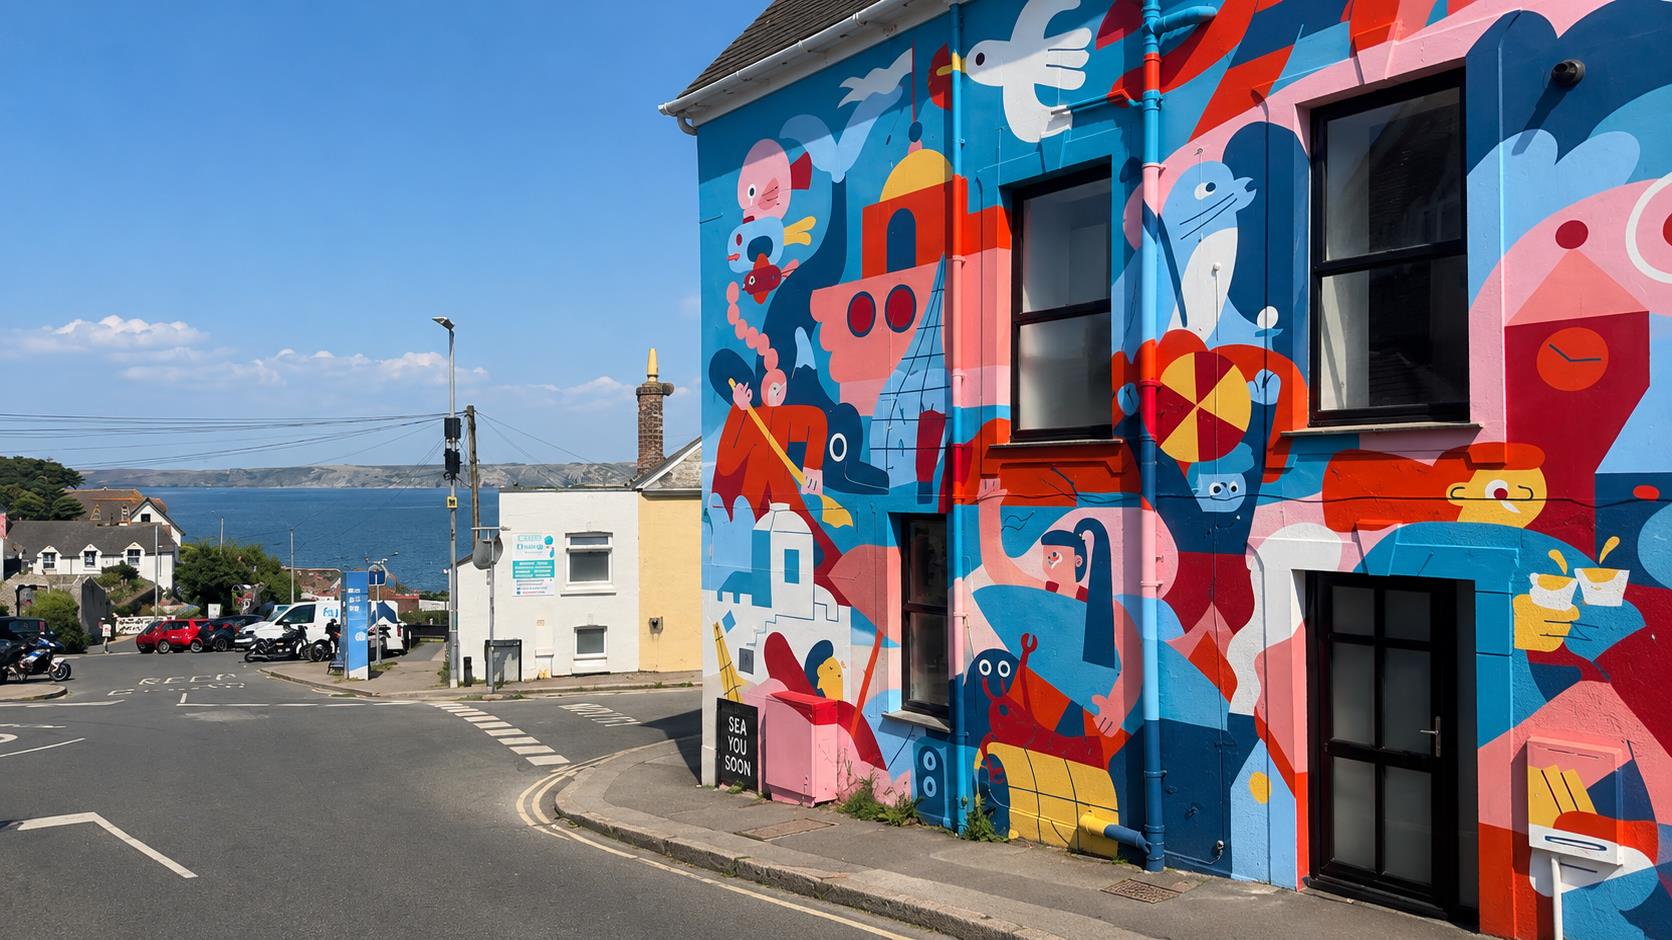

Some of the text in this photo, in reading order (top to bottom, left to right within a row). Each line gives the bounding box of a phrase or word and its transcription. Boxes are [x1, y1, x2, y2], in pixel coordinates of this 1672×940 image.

[728, 716, 747, 736] SEA
[728, 735, 747, 756] YOU
[725, 755, 751, 777] SOON
